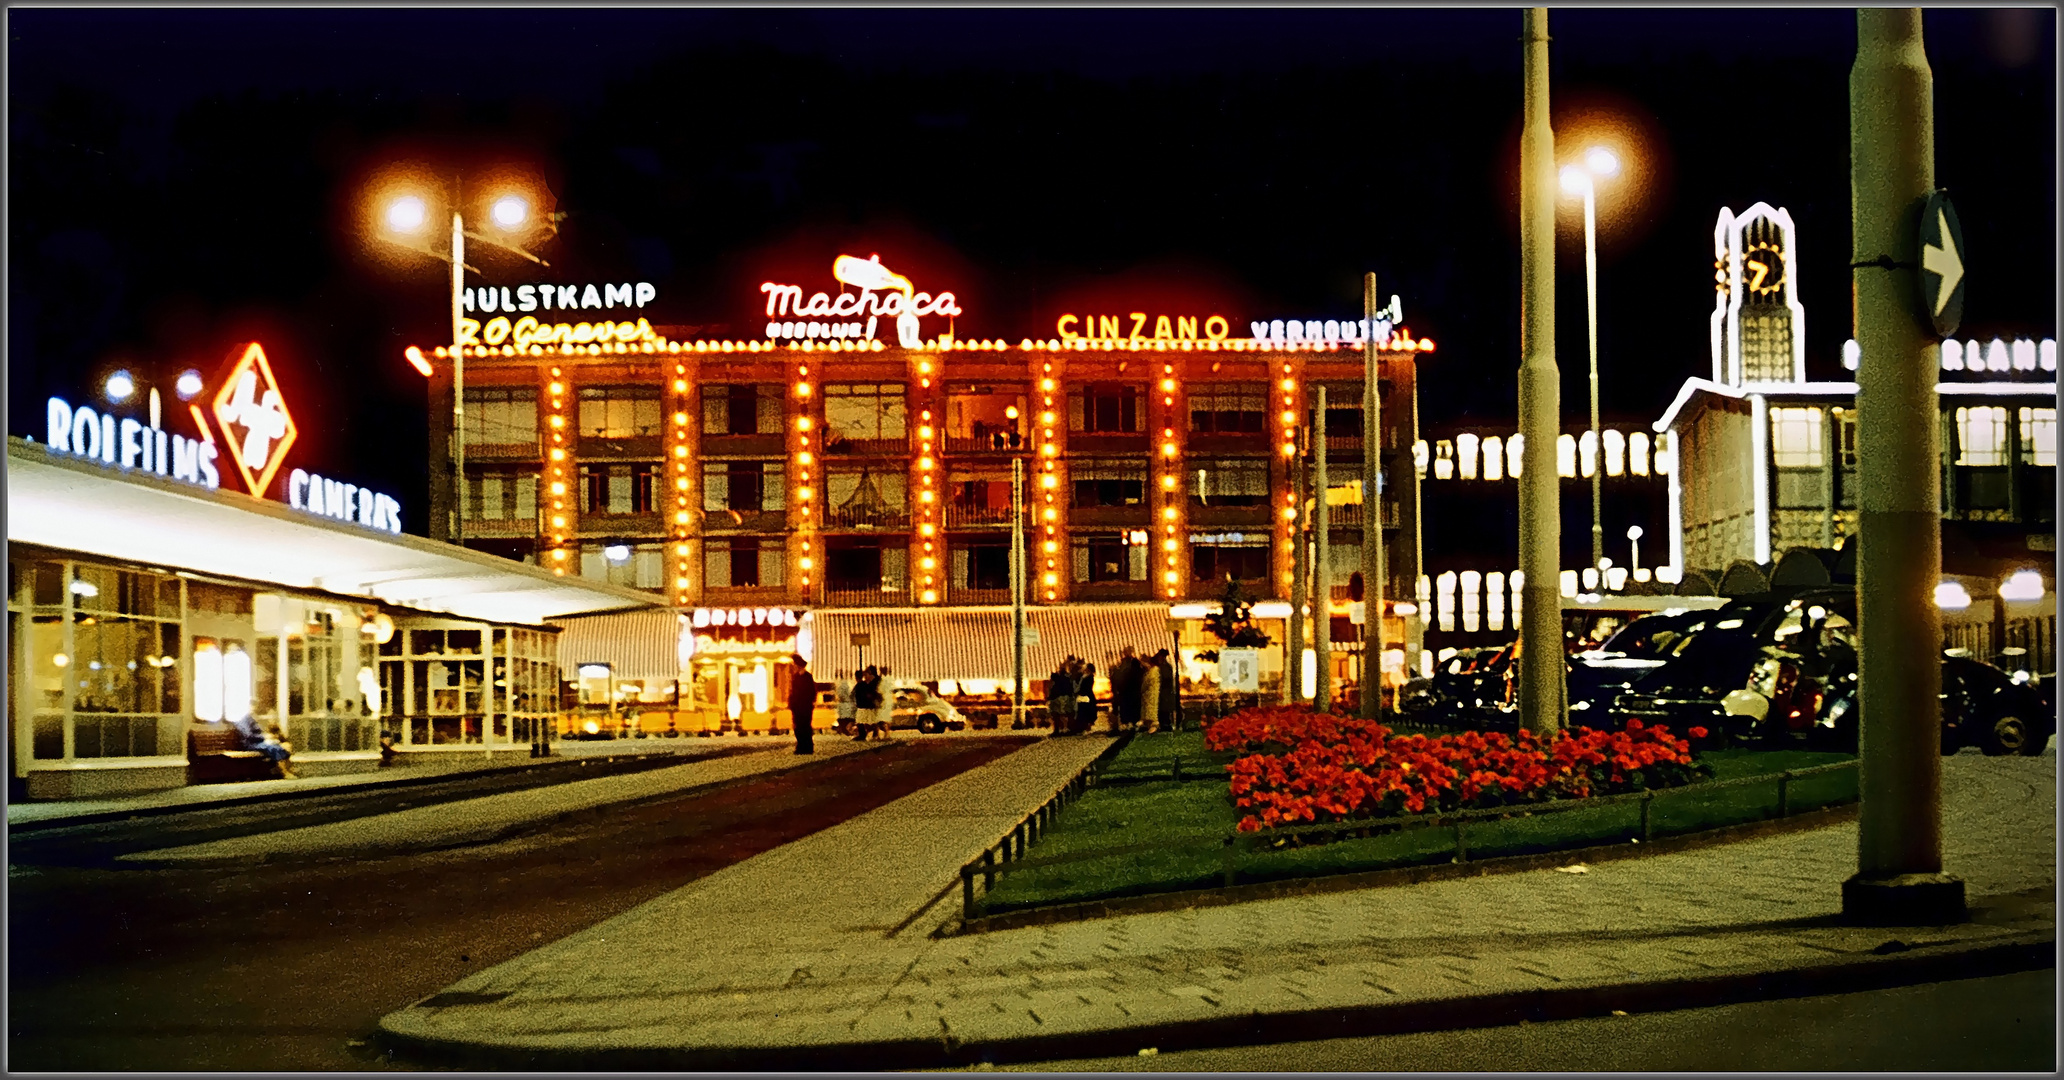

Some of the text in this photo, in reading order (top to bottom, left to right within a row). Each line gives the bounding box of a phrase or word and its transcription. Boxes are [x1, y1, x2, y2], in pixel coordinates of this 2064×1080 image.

[760, 282, 962, 317] Machoca
[1057, 312, 1230, 340] CINZANO
[693, 608, 797, 628] BRISTOL
